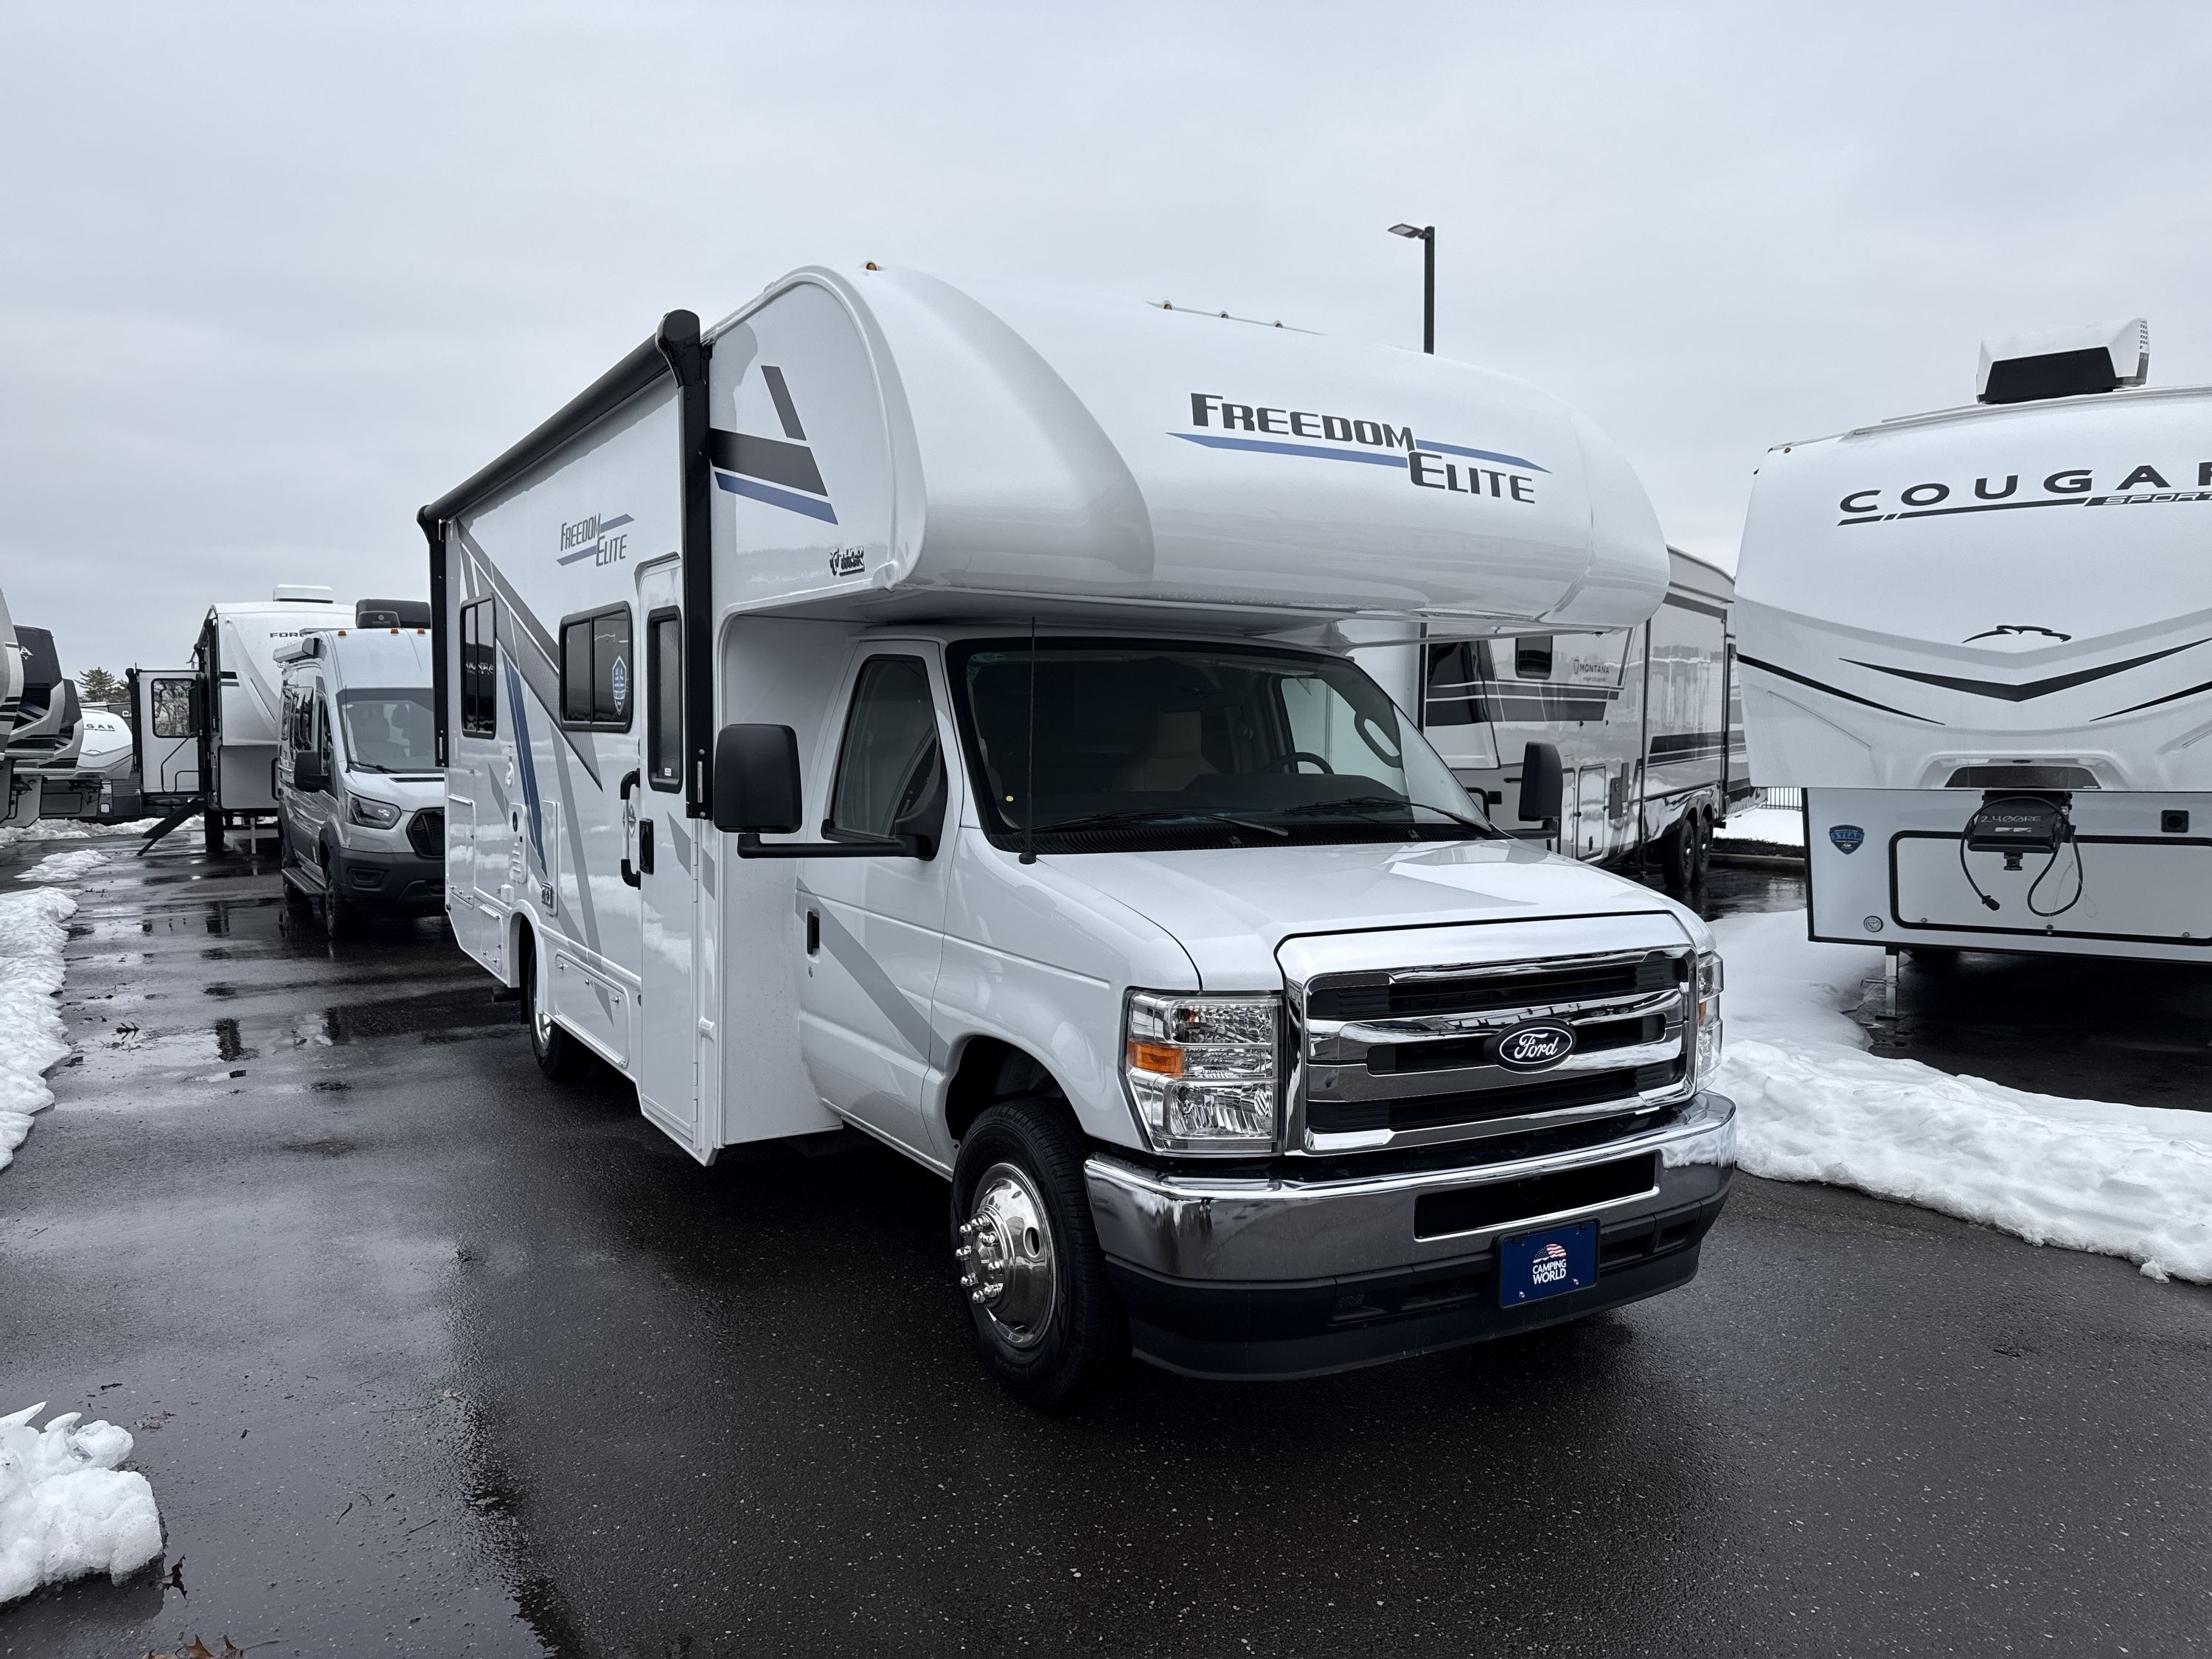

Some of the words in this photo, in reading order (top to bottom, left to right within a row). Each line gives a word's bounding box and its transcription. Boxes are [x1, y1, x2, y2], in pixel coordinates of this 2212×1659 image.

[1190, 392, 1416, 451] FREEDOM
[1408, 451, 1536, 504] ELITE
[560, 513, 601, 552] FREEDOM
[596, 534, 627, 567] ELITE
[1579, 663, 1610, 675] MONTANA
[1514, 1032, 1559, 1060] Ford
[1532, 1259, 1567, 1274] CAMPING
[1532, 1267, 1567, 1285] WORLD
